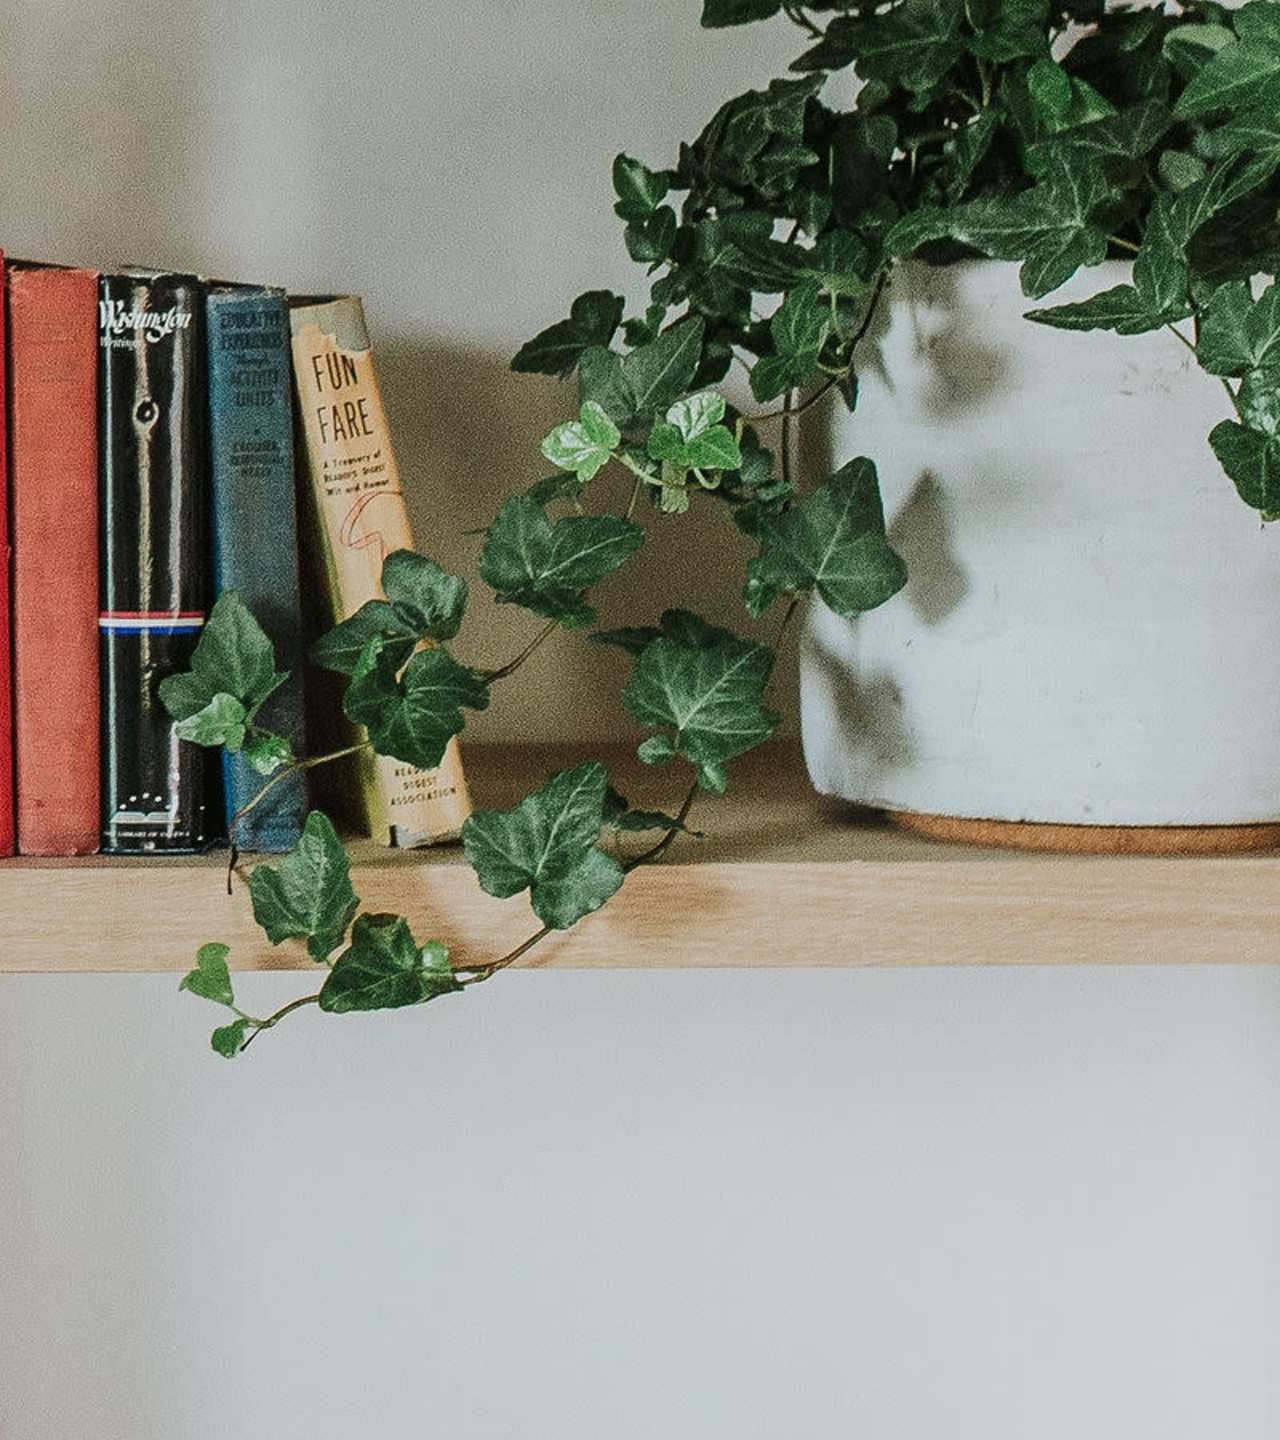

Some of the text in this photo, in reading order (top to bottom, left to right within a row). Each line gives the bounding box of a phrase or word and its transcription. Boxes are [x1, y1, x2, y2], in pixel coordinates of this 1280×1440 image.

[99, 300, 192, 343] Washington
[312, 351, 358, 393] FUN
[317, 398, 374, 444] FARE
